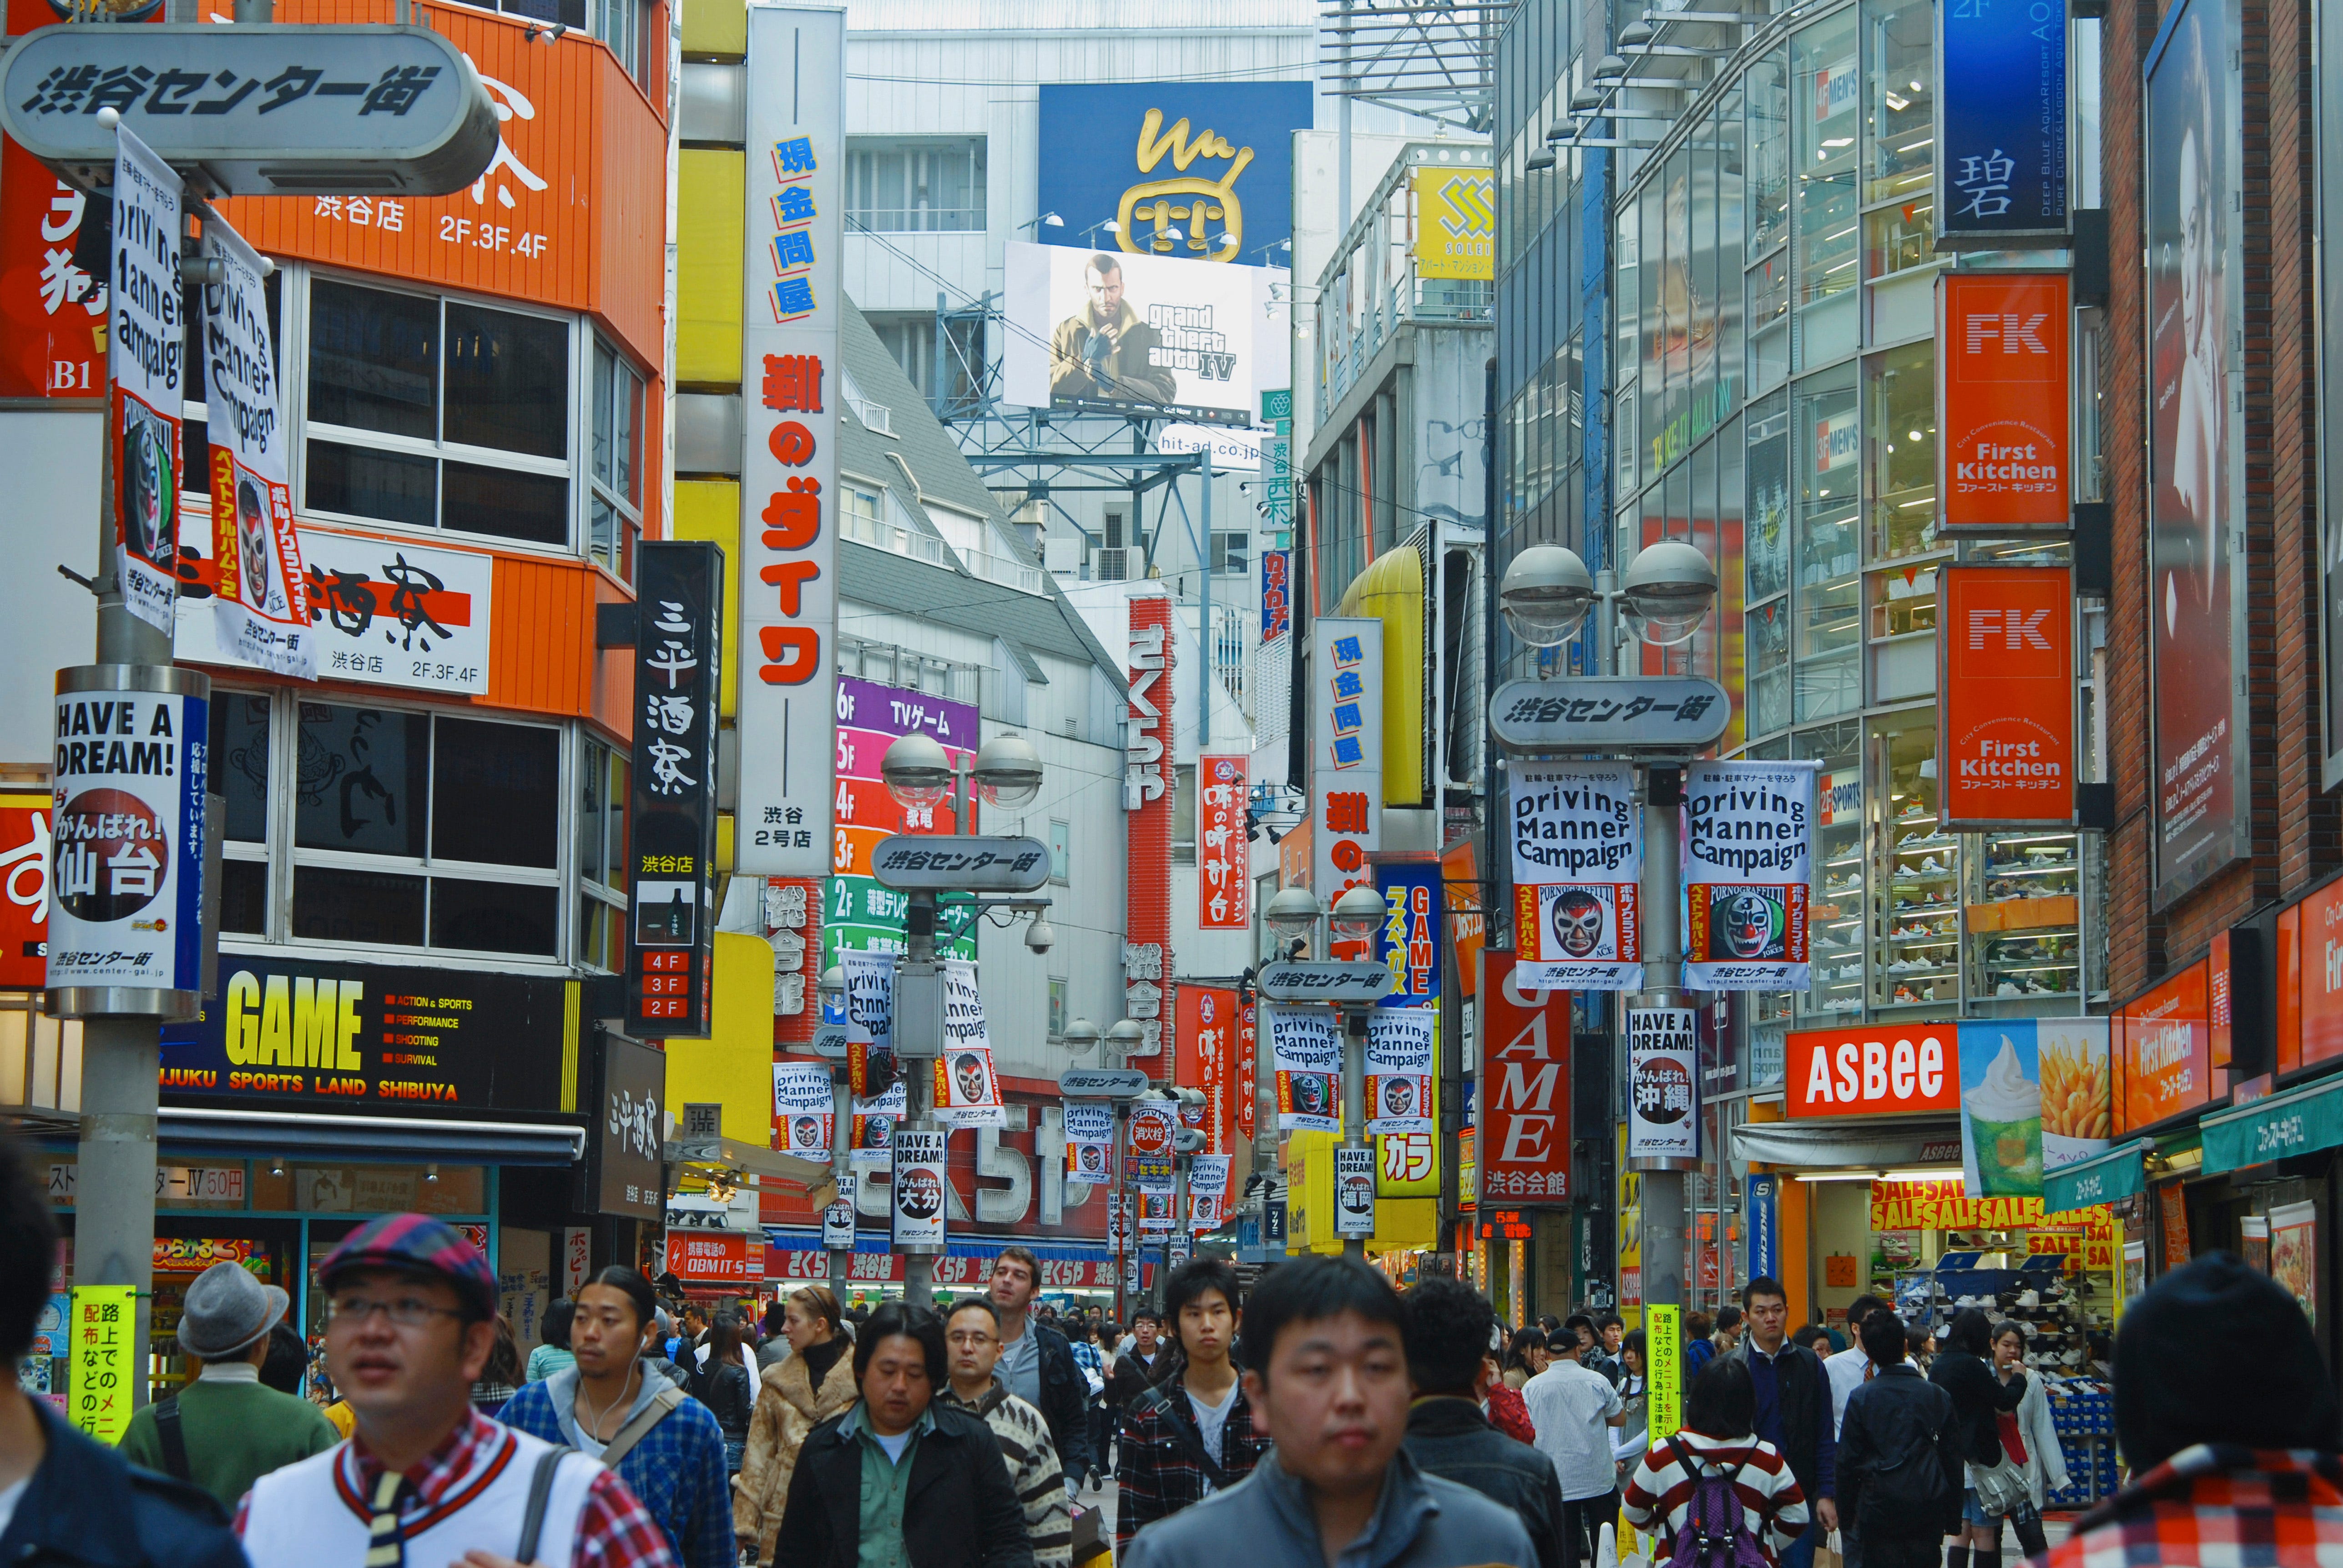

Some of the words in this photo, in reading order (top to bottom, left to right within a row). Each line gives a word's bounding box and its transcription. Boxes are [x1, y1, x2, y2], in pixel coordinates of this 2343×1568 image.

[2055, 37, 2063, 68] AQUA
[21, 65, 442, 116] 渋谷センター街
[1816, 82, 1828, 107] 4F
[1828, 67, 1857, 105] MEN'S
[2041, 141, 2050, 175] BLUE
[1954, 149, 2015, 219] 碧
[2042, 182, 2050, 217] DEEP
[2056, 184, 2064, 216] PURE
[314, 197, 404, 232] 渋谷店
[775, 136, 818, 316] 現金問屋
[1967, 313, 2049, 353] FK
[54, 361, 91, 389] B1
[1198, 353, 1237, 381] IV
[1652, 420, 1677, 474] TAKE
[1692, 395, 1711, 442] ALL
[1712, 376, 1732, 423] ON
[1957, 435, 1970, 449] City
[1970, 420, 2018, 435] Convenience
[2020, 421, 2056, 449] Restaurant
[1161, 436, 1259, 460] hit-ad.co.jp
[1818, 435, 1829, 459] 3F
[1829, 423, 1858, 458] MEN'S
[1977, 443, 2036, 460] First
[1957, 462, 2056, 479] Kitchen
[1958, 483, 2007, 493] ファースト
[2012, 483, 2056, 492] キッチン
[759, 353, 824, 686] 靴のダイワ
[271, 487, 308, 624] ポルノグラフィティ
[1969, 609, 2052, 649] FK
[332, 651, 383, 673] 渋谷店
[646, 600, 697, 795] 三平酒寮
[1333, 634, 1364, 765] 現金問屋
[1504, 695, 1716, 722] 渋谷センター街
[58, 701, 134, 738] HAVE
[151, 704, 173, 737] A
[837, 682, 854, 720] 6F
[890, 701, 949, 736] TVゲーム
[1960, 731, 1974, 745] City
[1973, 717, 2021, 732] Convenience
[2023, 718, 2060, 746] Restaurant
[57, 741, 174, 776] DREAM!
[837, 731, 854, 770] 5F
[1981, 740, 2040, 757] First
[1525, 774, 1619, 783] 駐輪・駐車マナーを守ろう
[1703, 774, 1796, 783] 駐輪・駐車マナーを守ろう
[1961, 759, 2060, 776] Kitchen
[1961, 780, 2011, 789] ファースト
[2015, 780, 2060, 789] キッチン
[836, 781, 854, 819] 4F
[1516, 785, 1629, 821] Driving
[1692, 786, 1804, 822] Driving
[1821, 788, 1832, 813] 2F
[1833, 781, 1861, 813] SPORTS
[764, 807, 803, 825] 渋谷
[58, 814, 163, 841] がんばれ!
[1517, 817, 1630, 840] Manner
[1691, 817, 1805, 840] Manner
[755, 830, 812, 848] 2号店
[835, 830, 853, 868] 3F
[881, 850, 1041, 872] 渋谷センター街
[1204, 783, 1233, 922] 味の時計台
[1517, 840, 1632, 877] Campaign
[1691, 838, 1806, 877] Campaign
[57, 842, 161, 897] 仙台
[642, 856, 694, 873] 渋谷店
[835, 879, 853, 917] 2F
[1519, 886, 1535, 961] ベストアルバム×2
[1620, 884, 1636, 961] ポルノグラフィティ
[1792, 884, 1805, 961] ポルノグラフィティ
[2325, 906, 2334, 929] City
[1385, 886, 1408, 995] ラスベガス
[1409, 886, 1433, 995] GAME
[1762, 945, 1785, 958] JOKER
[55, 952, 154, 966] 渋谷センター街
[1596, 948, 1614, 958] ACE
[1269, 973, 1386, 988] 渋谷センター街
[1545, 966, 1620, 978] 渋谷センター街
[1712, 966, 1787, 978] 渋谷センター街
[398, 995, 428, 1007] ACTION
[439, 998, 472, 1010] SPORTS
[226, 970, 364, 1071] GAME
[396, 1015, 458, 1028] PERFORMANCE
[1274, 1018, 1334, 1040] Driving
[1464, 1011, 1472, 1032] 5F
[1632, 1013, 1675, 1031] HAVE
[1682, 1014, 1692, 1031] A
[396, 1034, 439, 1046] SHOOTING
[1275, 1035, 1335, 1049] Manner
[1368, 1022, 1430, 1042] Driving
[1632, 1034, 1693, 1051] DREAM!
[1368, 1039, 1430, 1051] Manner
[2141, 1032, 2158, 1077] First
[2161, 1020, 2192, 1069] Kitchen
[395, 1054, 437, 1065] SURVIVAL
[1276, 1046, 1336, 1068] Campaign
[1367, 1050, 1430, 1070] Campaign
[778, 1072, 830, 1087] Driving
[1635, 1069, 1690, 1084] がんばれ!
[1806, 1037, 1944, 1104] ASBee
[229, 1073, 303, 1092] SPORTS
[315, 1077, 366, 1095] LAND
[379, 1081, 458, 1100] SHIBUYA
[778, 1085, 830, 1095] Manner
[1065, 1077, 1142, 1088] 渋谷センター街
[778, 1094, 831, 1111] Campaign
[1636, 1084, 1691, 1112] 沖縄
[1067, 1106, 1111, 1121] Driving
[1067, 1119, 1110, 1127] Manner
[609, 1089, 656, 1161] 三平酒寮
[1067, 1126, 1111, 1140] Campaign
[1135, 1126, 1164, 1141] 消火栓
[898, 1135, 930, 1148] HAVE
[935, 1136, 942, 1148] A
[1919, 1143, 1960, 1161] ASBee
[897, 1150, 943, 1163] DREAM!
[1126, 1160, 1138, 1174] 質
[1340, 1152, 1365, 1161] HAVE
[1368, 1152, 1373, 1161] A
[1384, 1134, 1434, 1182] カラ
[1138, 1165, 1170, 1175] セキネ
[1192, 1172, 1225, 1181] Manner
[1193, 1162, 1226, 1175] Driving
[1340, 1163, 1373, 1173] DREAM!
[207, 1168, 243, 1197] 50円
[899, 1178, 940, 1189] がんばれ!
[1191, 1180, 1225, 1192] Campaign
[1342, 1183, 1372, 1191] がんばれ!
[1487, 1171, 1565, 1195] 渋谷会館
[899, 1189, 940, 1210] 大分
[1342, 1191, 1372, 1207] 福岡
[828, 1210, 852, 1223] 高松
[1871, 1200, 1923, 1230] SALE
[1923, 1199, 1978, 1229] SALE
[688, 1241, 726, 1257] 携帯電話の
[2029, 1235, 2081, 1254] SALE
[569, 1230, 587, 1286] ホッピー
[687, 1258, 718, 1273] OBM
[852, 1254, 893, 1279] 渋谷店
